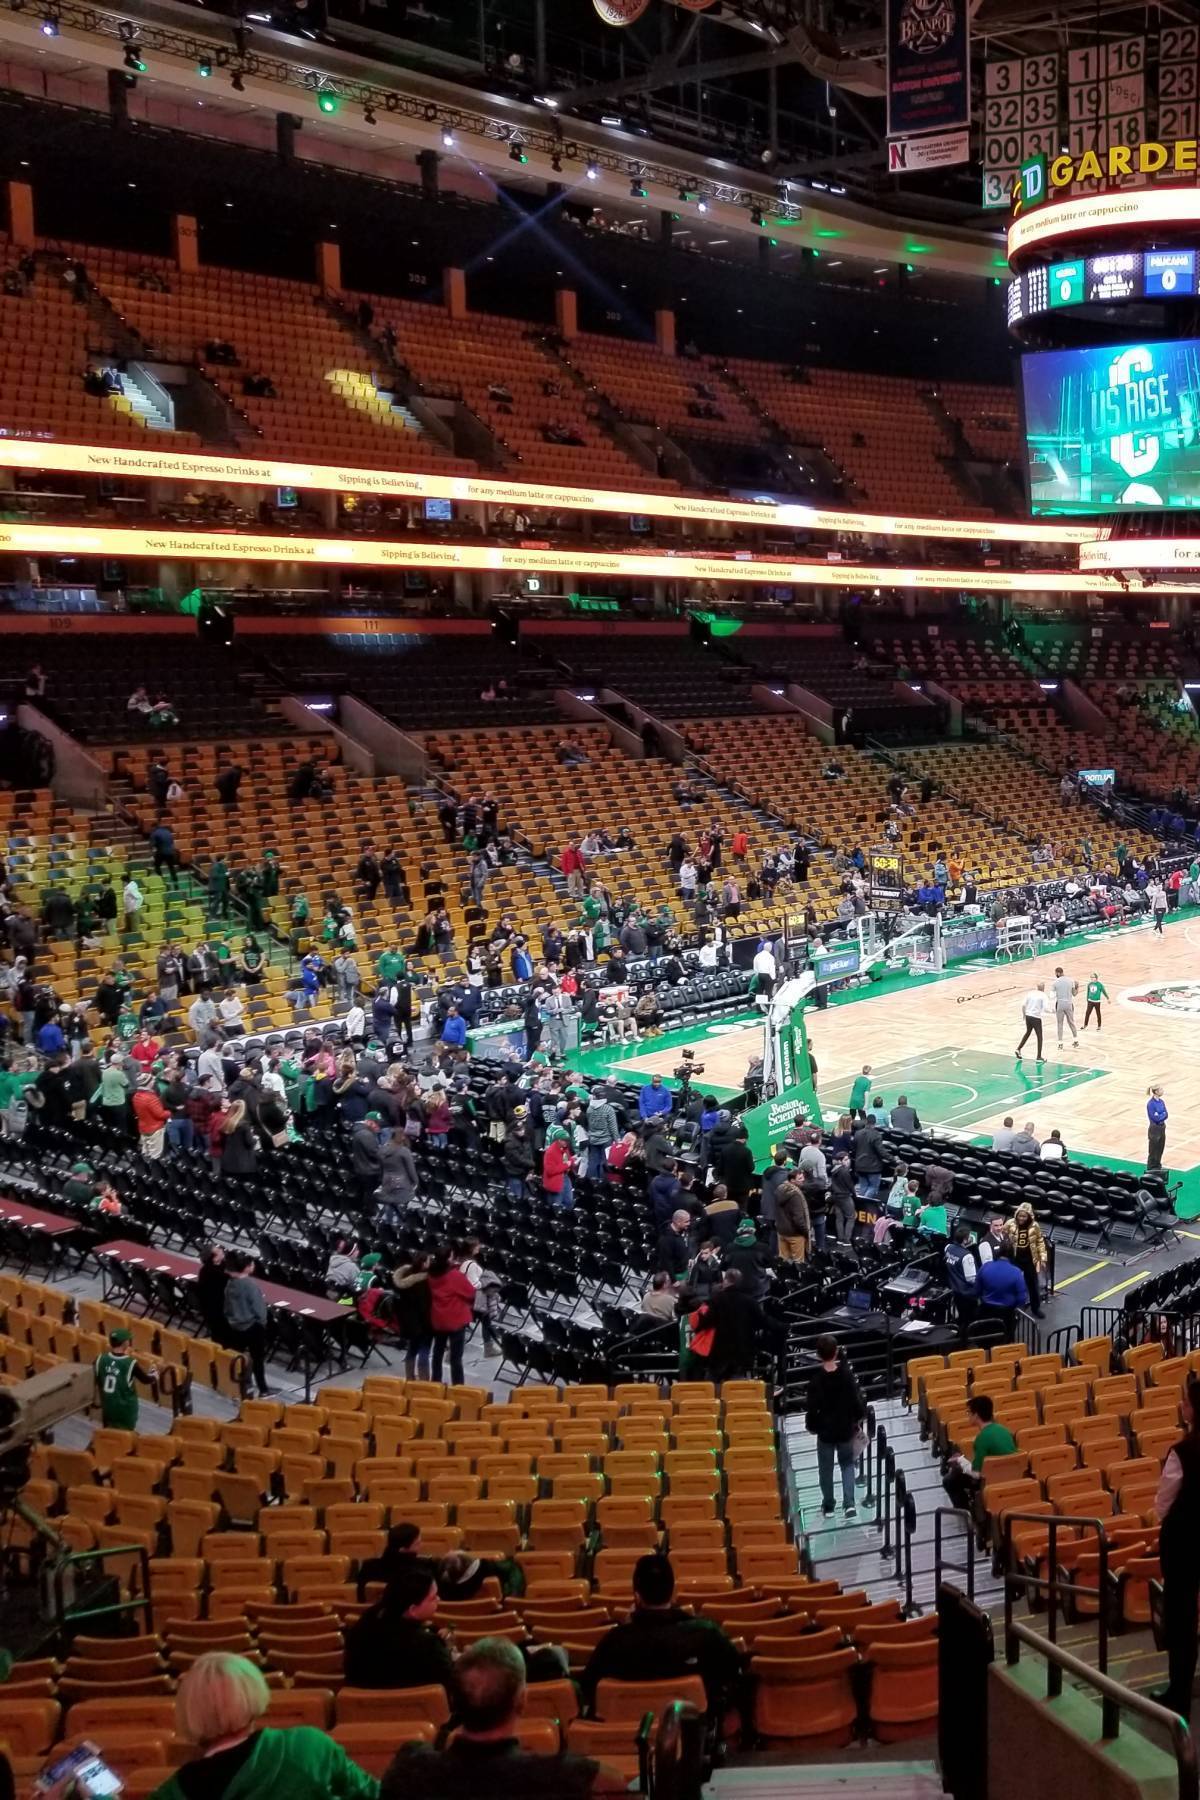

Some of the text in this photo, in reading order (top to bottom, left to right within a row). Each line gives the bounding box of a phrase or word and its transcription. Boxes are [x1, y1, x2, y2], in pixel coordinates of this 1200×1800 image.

[902, 13, 953, 40] BEANPOT
[1162, 29, 1197, 60] 22
[1079, 41, 1141, 80] 1 16
[996, 57, 1057, 92] 3 33
[1160, 66, 1195, 98] 23
[988, 94, 1057, 128] 32 35
[1074, 87, 1102, 116] 19
[1161, 106, 1194, 136] 21
[987, 136, 1020, 165] 00
[1029, 130, 1055, 158] 31
[1073, 117, 1140, 154] 17 18
[889, 143, 907, 171] N
[988, 172, 1016, 201] 34
[1022, 164, 1042, 199] TD
[1061, 211, 1077, 222] latte
[1078, 210, 1086, 218] or
[1088, 203, 1139, 216] cappuccino
[1060, 279, 1072, 301] 0
[1161, 269, 1177, 291] 0
[1091, 373, 1173, 433] US RISE
[87, 454, 271, 478] New Handcrafted Espresso Drinks at
[338, 473, 372, 487] Sipping
[373, 476, 380, 486] is
[468, 485, 480, 495] for
[481, 487, 495, 498] any
[496, 487, 527, 498] medium
[531, 490, 545, 500] latte
[554, 491, 594, 505] cappuccino
[146, 538, 315, 556] New Handcrafted Espresso Drinks at
[381, 549, 413, 561] Sipping
[414, 551, 421, 559] is
[1174, 548, 1191, 560] for
[514, 556, 527, 566] any
[529, 555, 557, 567] medium
[583, 560, 620, 570] cappuccino
[50, 617, 72, 629] 109
[362, 619, 379, 631] 111
[874, 857, 899, 870] 60:38
[768, 1101, 811, 1127] Scientific
[771, 1099, 800, 1114] Boston
[853, 1209, 878, 1226] DEN
[104, 1374, 117, 1393] 0
